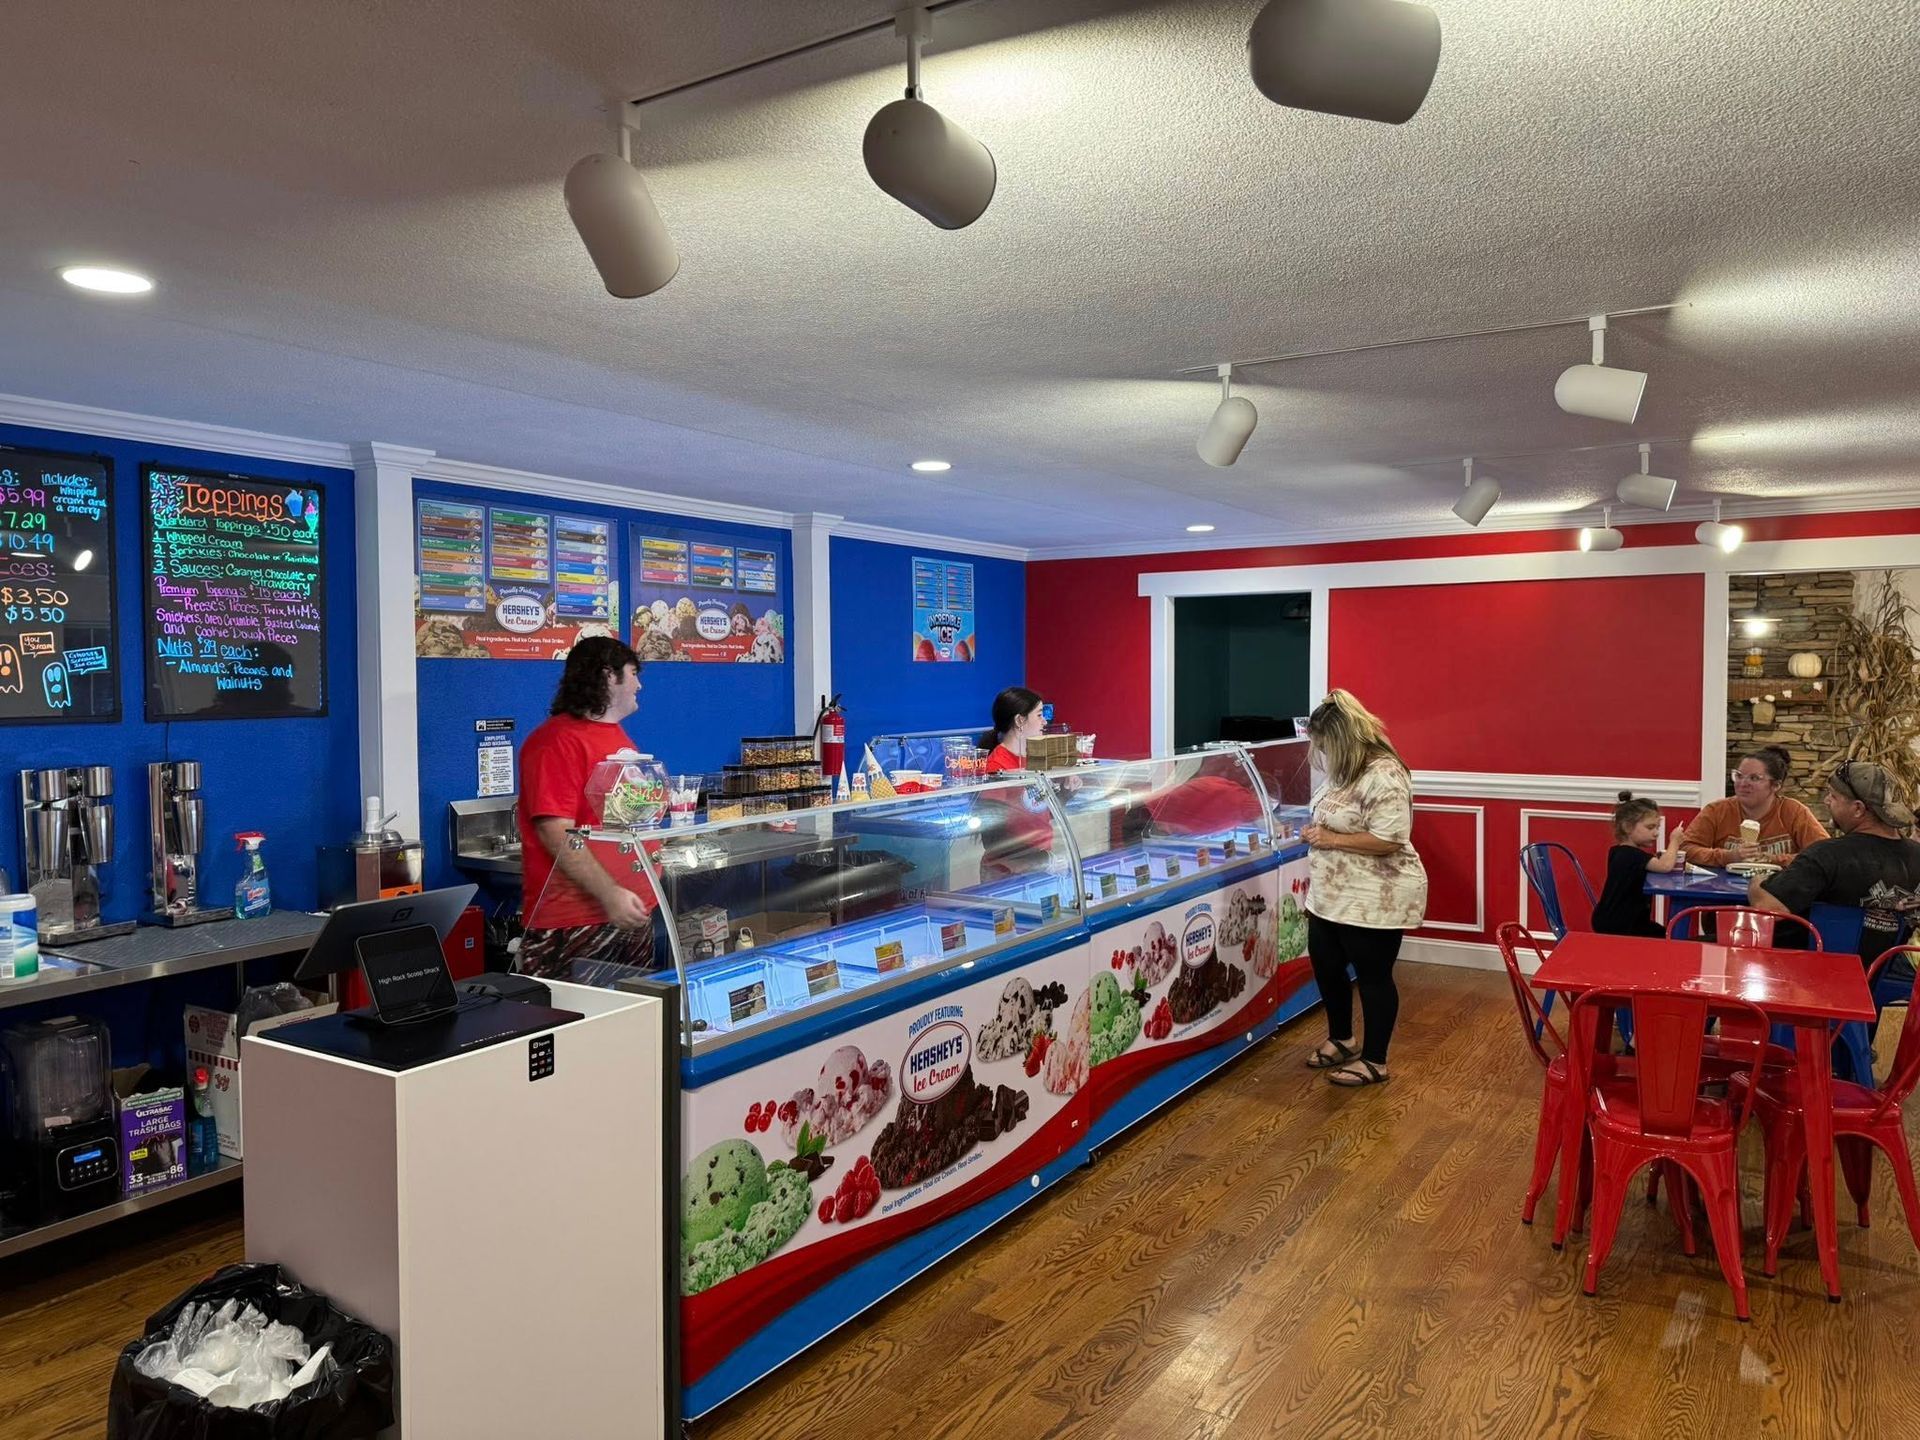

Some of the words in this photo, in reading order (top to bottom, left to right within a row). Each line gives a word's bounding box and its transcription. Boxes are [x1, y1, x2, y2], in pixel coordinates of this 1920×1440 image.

[176, 483, 283, 521] Toppings
[153, 514, 208, 528] Standard
[214, 518, 260, 537] Toppings
[1, 586, 69, 606] $3.50
[5, 605, 65, 624] $5.50
[502, 604, 540, 616] HERSHEY'S
[938, 626, 953, 644] ICE
[157, 637, 193, 655] Nuts
[908, 1010, 935, 1038] PROUDLY
[934, 1006, 963, 1021] FEATURING
[910, 1035, 963, 1075] HERSHEY'S
[913, 1075, 928, 1094] Ice
[928, 1063, 960, 1086] Cream
[128, 1125, 157, 1138] TRASH
[158, 1119, 182, 1131] BAGS
[141, 1115, 169, 1128] LARGE
[169, 1163, 184, 1175] 86
[128, 1173, 144, 1185] 33
